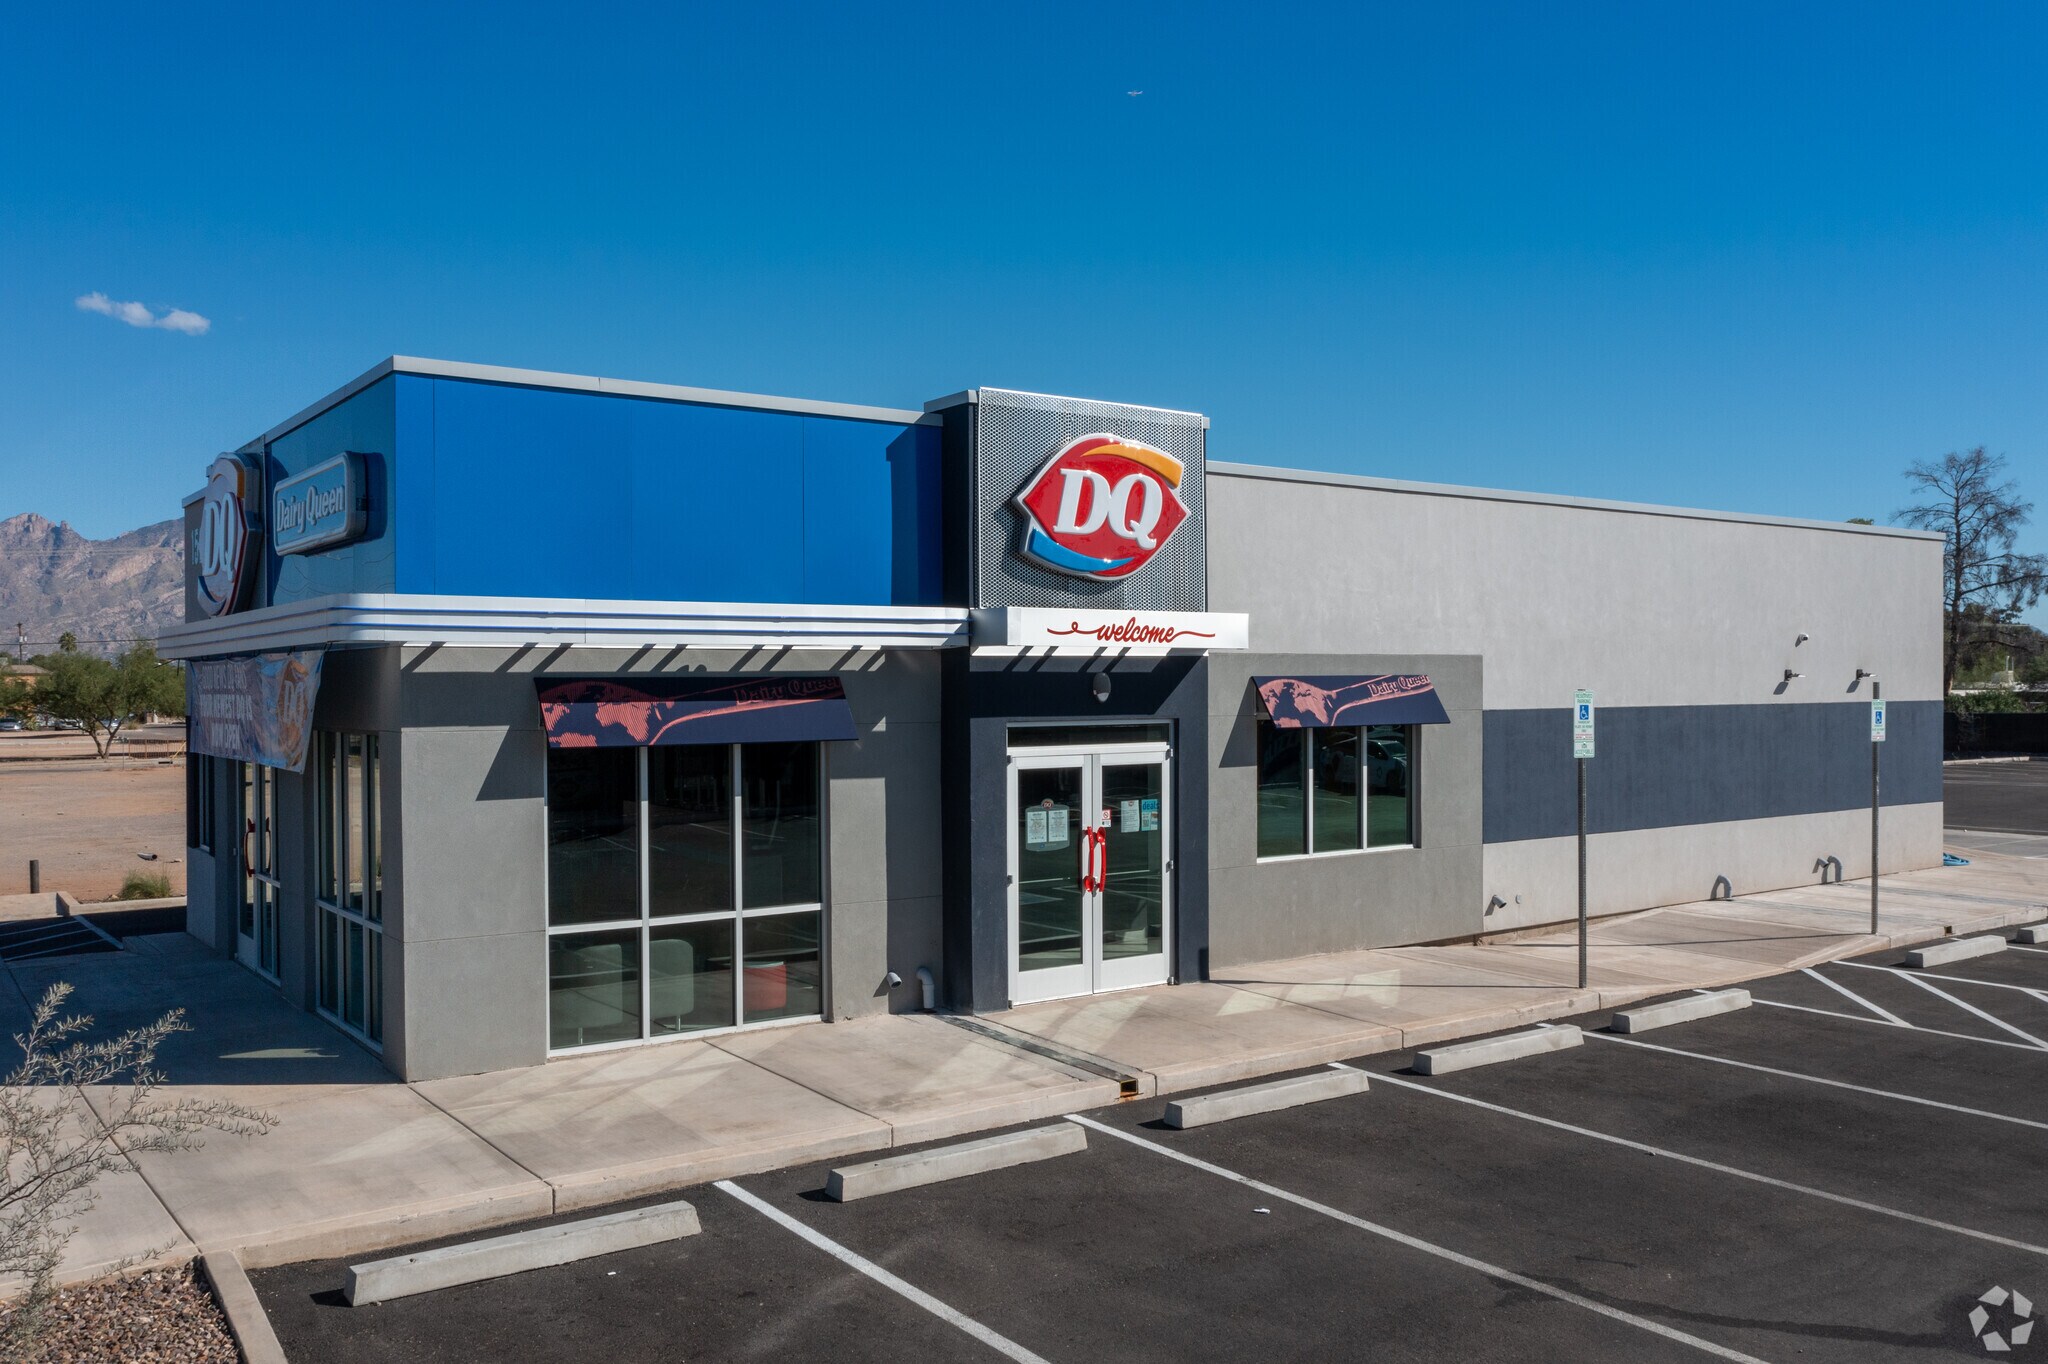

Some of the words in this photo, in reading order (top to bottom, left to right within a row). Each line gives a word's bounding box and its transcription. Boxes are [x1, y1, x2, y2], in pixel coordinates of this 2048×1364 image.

[276, 496, 305, 533] Dairy
[306, 485, 345, 526] Queen
[1053, 467, 1163, 550] DQ
[203, 491, 238, 582] DQ
[1094, 616, 1180, 643] welcome
[282, 680, 307, 726] DQ
[1367, 682, 1399, 696] Dairy
